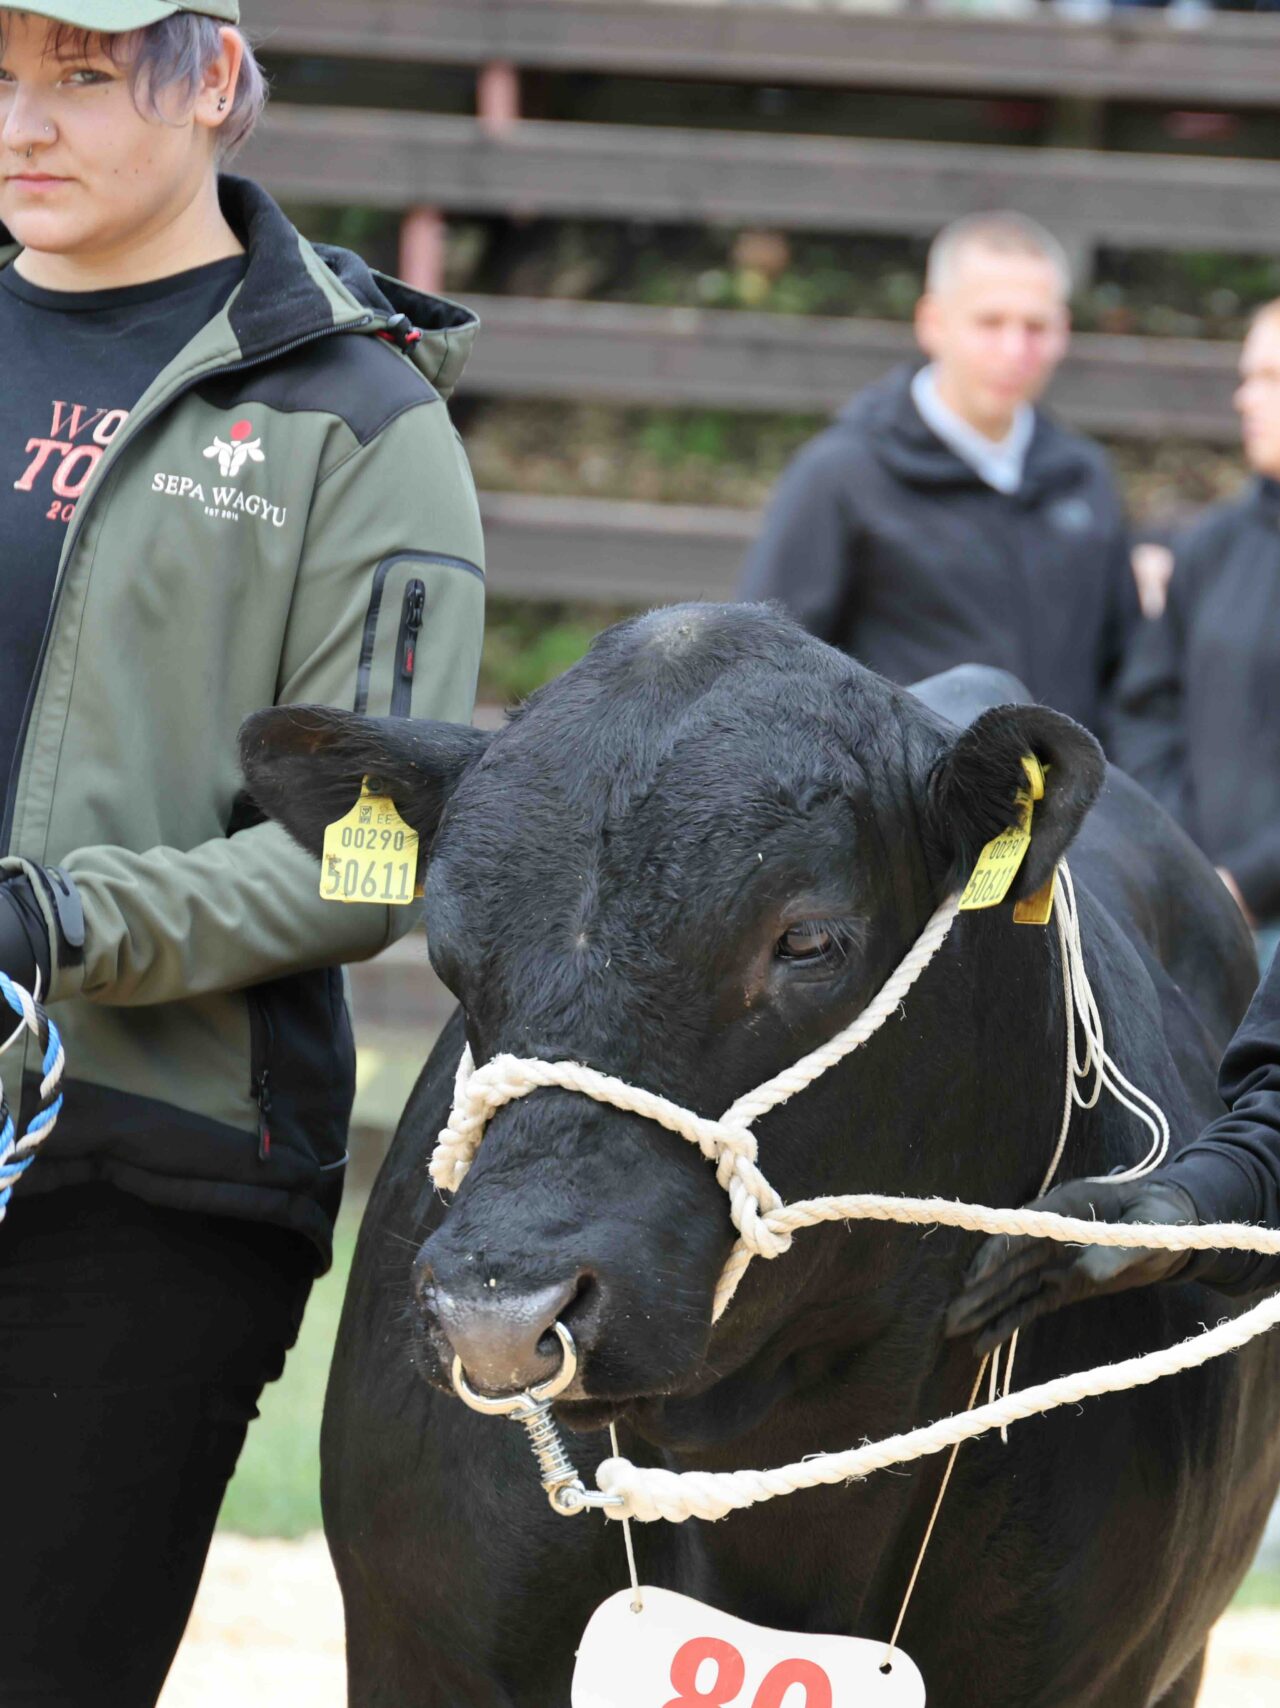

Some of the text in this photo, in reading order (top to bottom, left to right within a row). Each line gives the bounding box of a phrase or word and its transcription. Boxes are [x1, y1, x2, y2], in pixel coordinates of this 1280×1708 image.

[151, 472, 287, 528] SEPA WAGYU
[377, 813, 394, 825] EE
[341, 826, 405, 852] 00290
[325, 857, 410, 900] 50611
